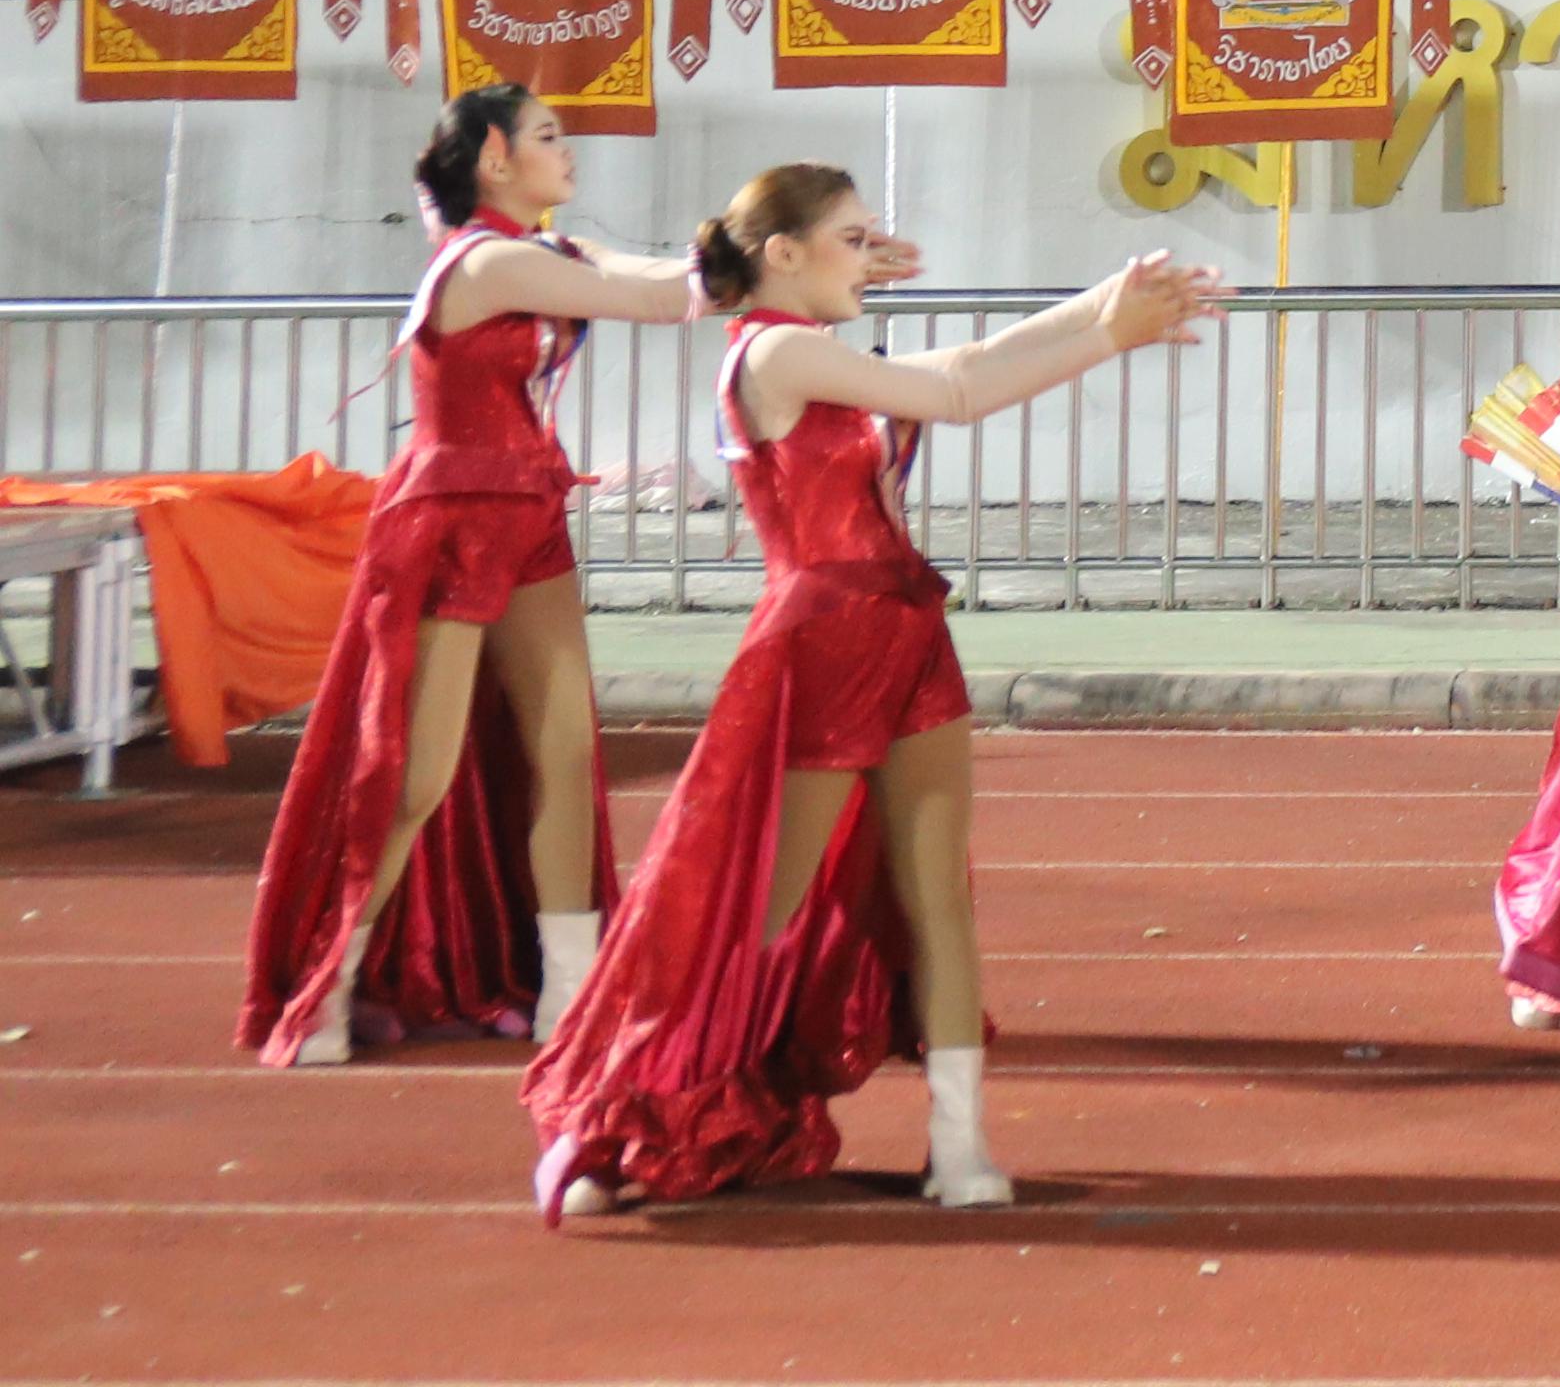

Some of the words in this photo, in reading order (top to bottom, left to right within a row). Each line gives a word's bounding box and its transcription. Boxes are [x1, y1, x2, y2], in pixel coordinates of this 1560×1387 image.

[1214, 33, 1353, 82] วิชาภาษาไทย
